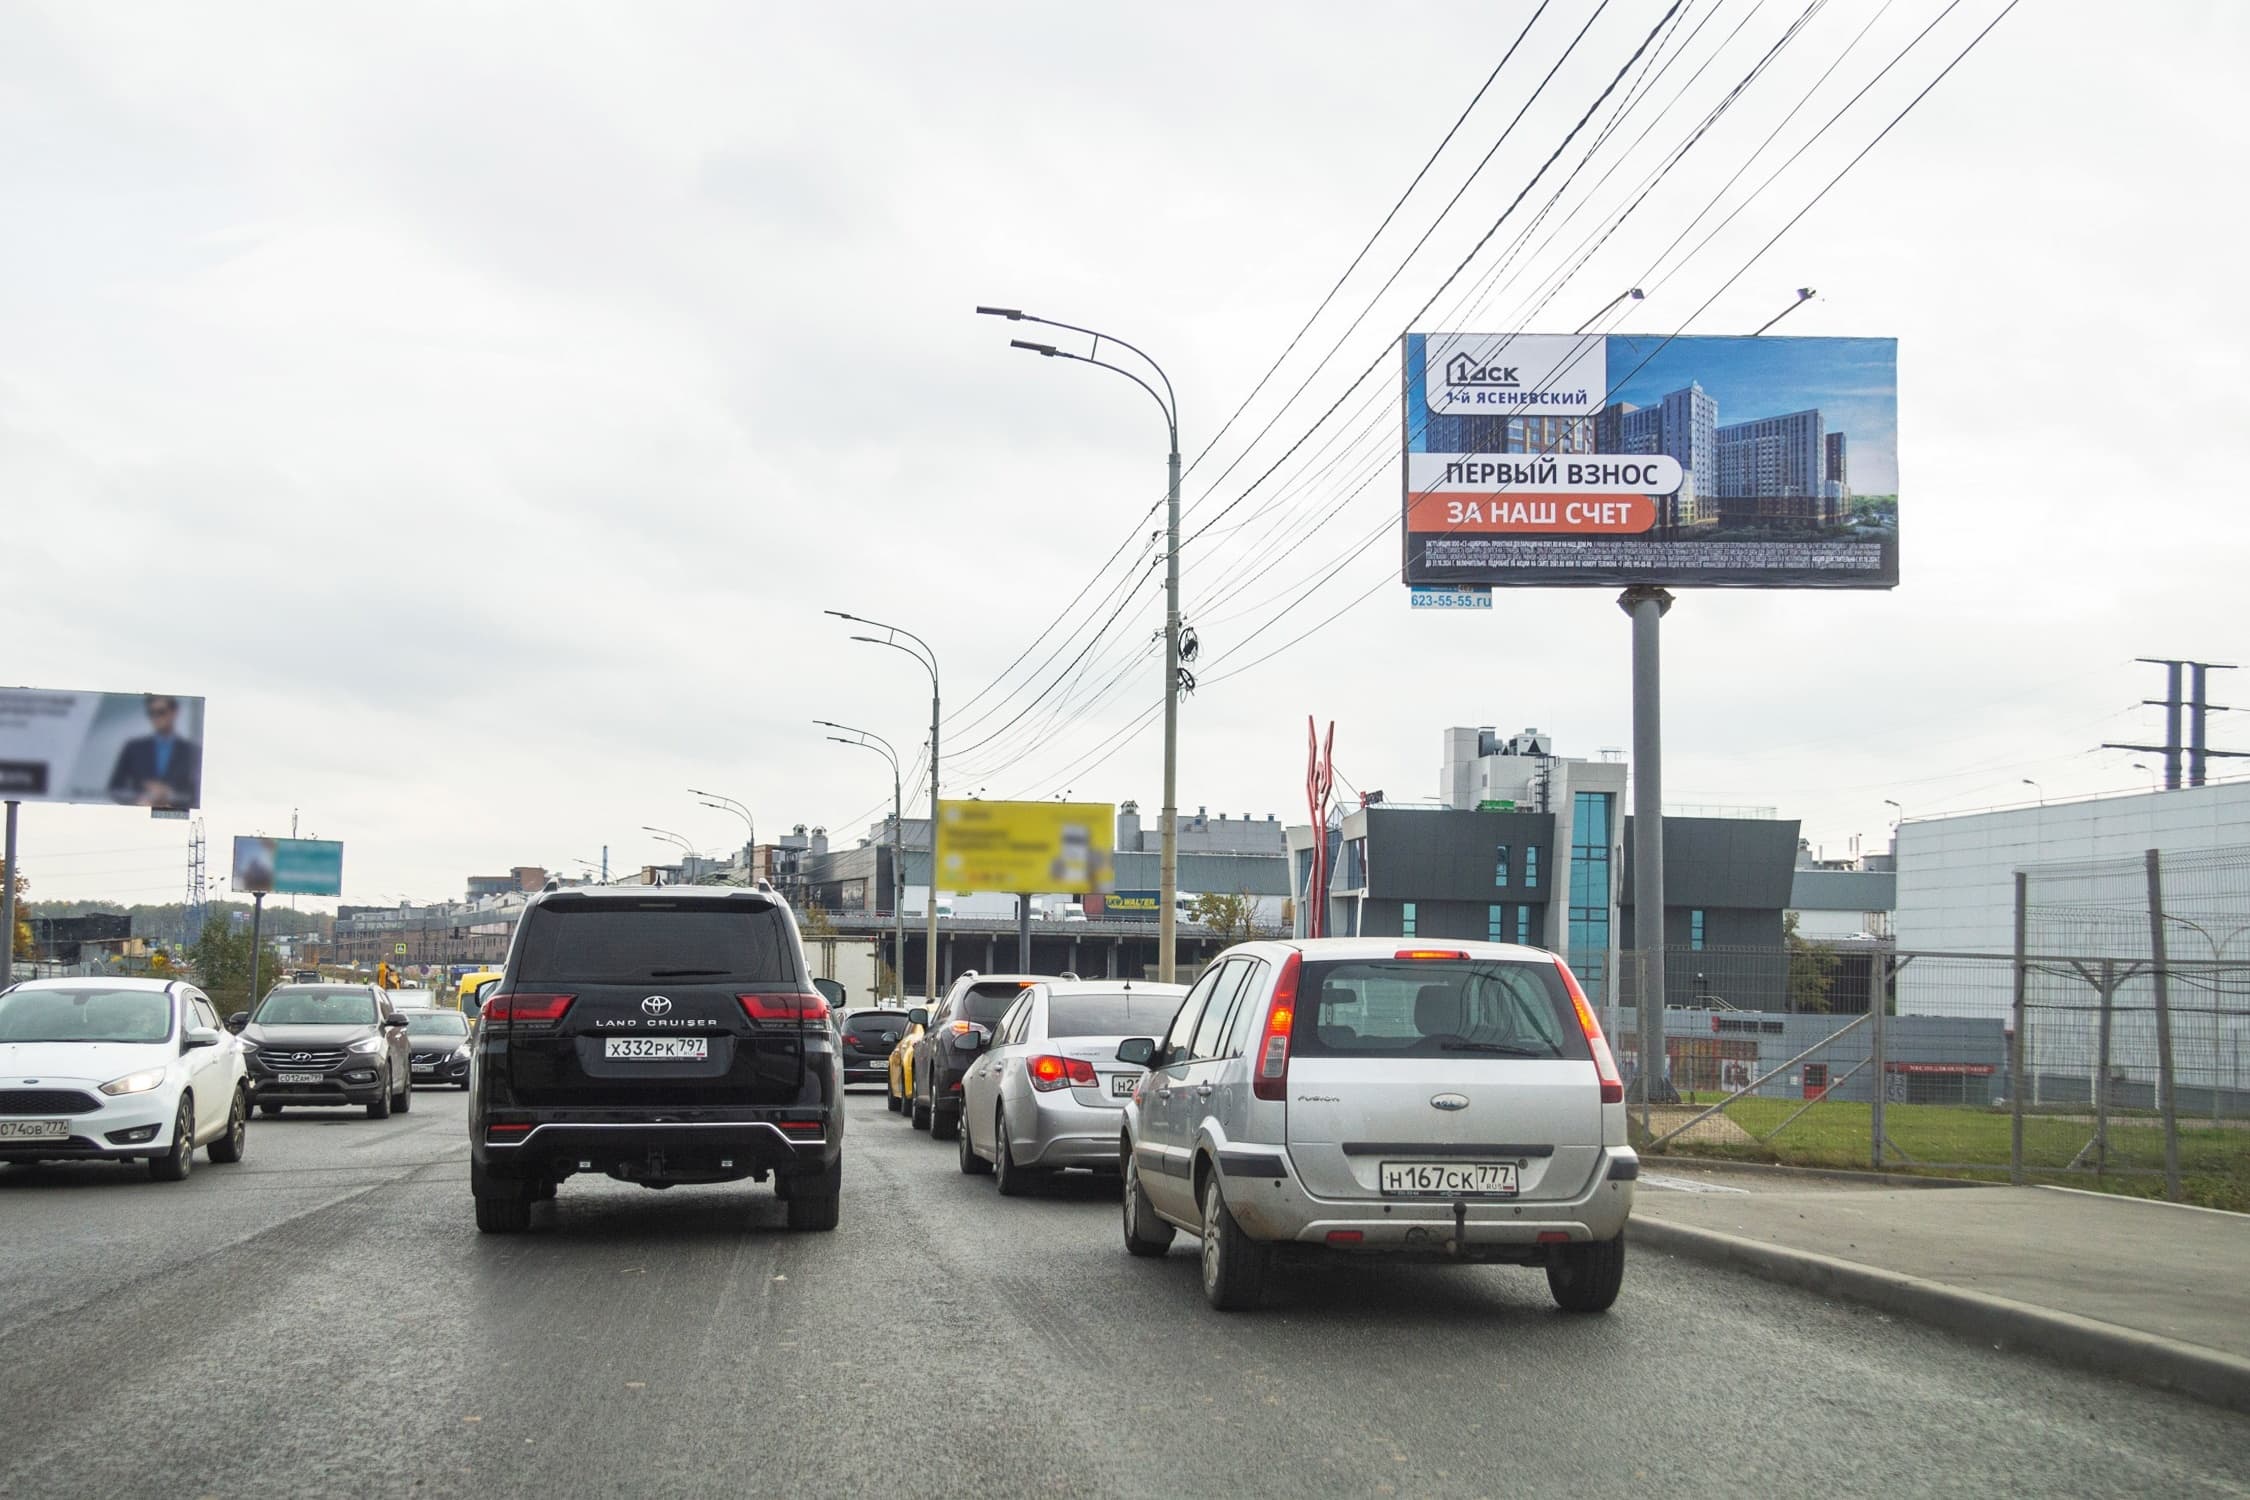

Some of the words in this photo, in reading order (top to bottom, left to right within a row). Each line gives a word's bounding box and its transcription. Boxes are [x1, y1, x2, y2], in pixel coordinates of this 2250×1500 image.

[1446, 391, 1470, 404] 1-й
[1476, 389, 1588, 405] ЯСЕНЕВСКИЙ
[1447, 457, 1557, 485] ПЕРВЫЙ
[1567, 463, 1658, 485] ВЗНОС
[1447, 501, 1482, 524] ЗА
[1491, 502, 1556, 524] НАШ
[1565, 503, 1632, 524] СЧЕТ
[1411, 595, 1491, 607] 623-55-55.ru
[611, 1040, 674, 1056] Х332РК
[678, 1039, 704, 1051] 797
[45, 1121, 65, 1132] 777
[1390, 1167, 1474, 1189] Н167СК
[1478, 1166, 1510, 1183] 777
